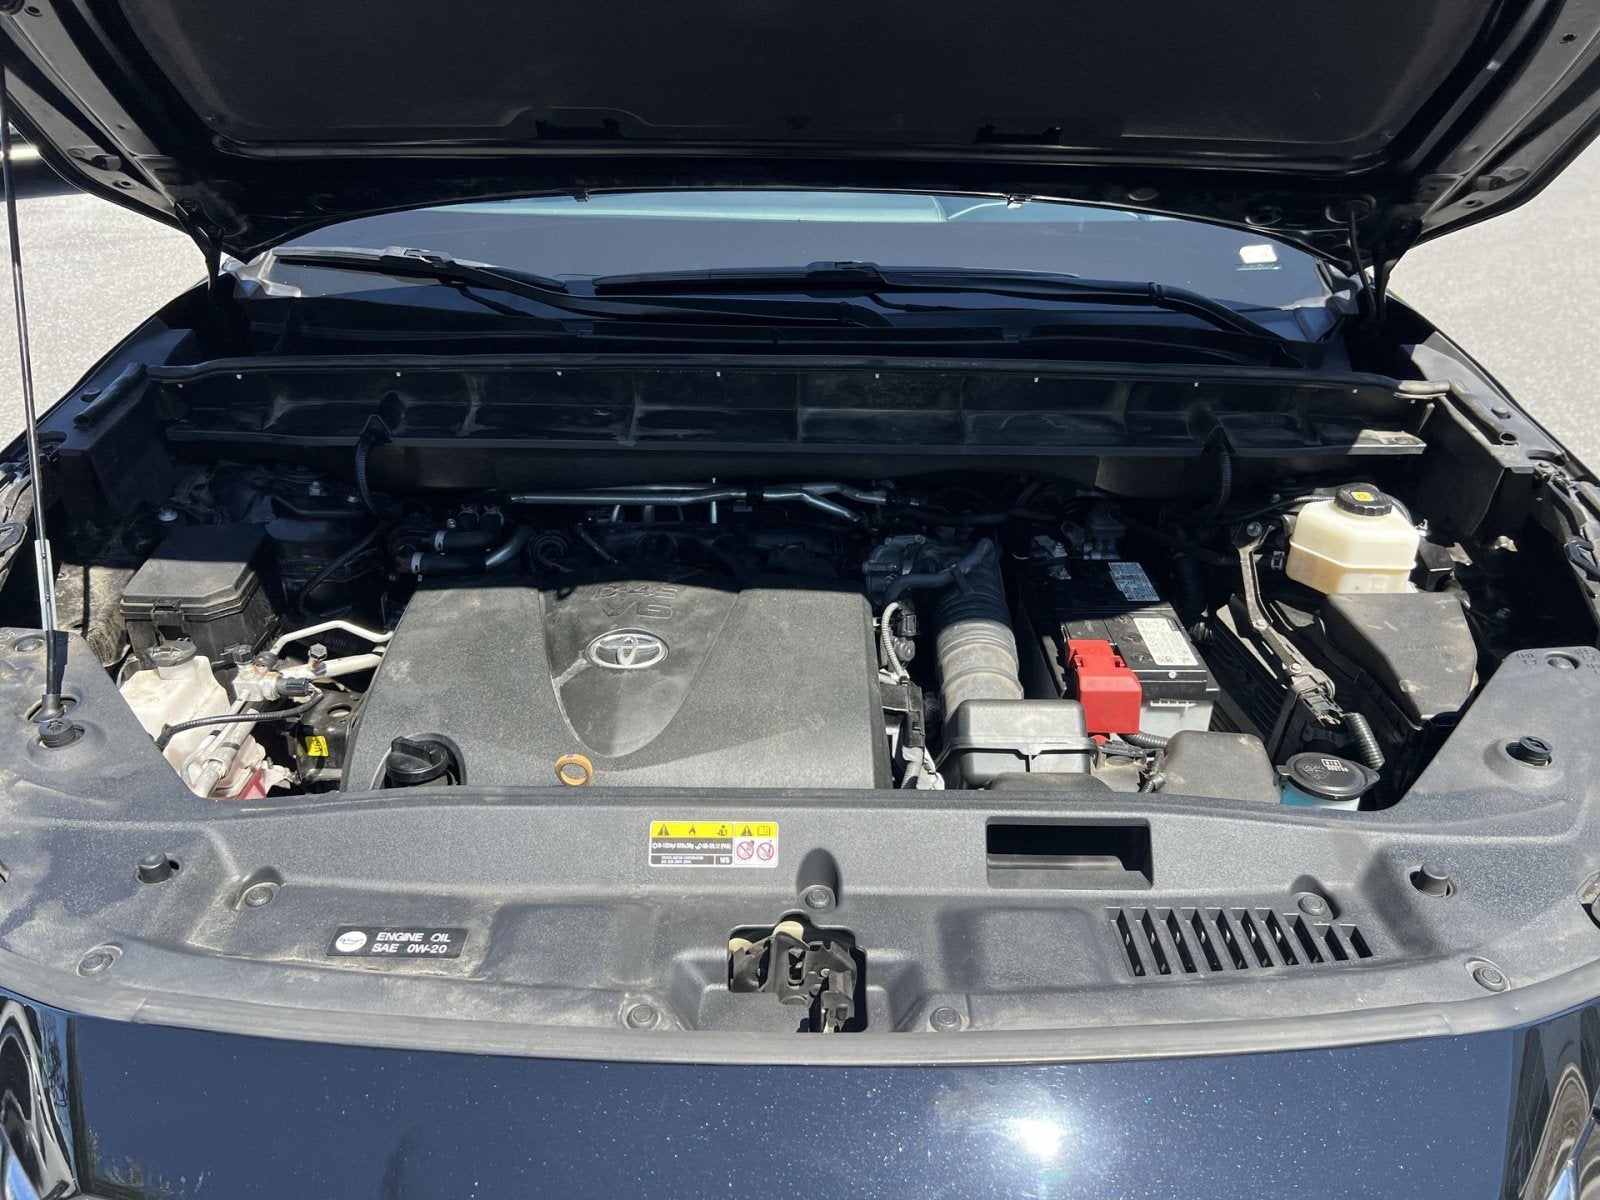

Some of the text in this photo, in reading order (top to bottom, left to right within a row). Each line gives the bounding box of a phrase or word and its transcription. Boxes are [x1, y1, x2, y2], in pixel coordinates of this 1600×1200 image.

[598, 601, 673, 620] V6
[376, 931, 451, 942] ENGINE OIL
[371, 943, 447, 954] SAE 0W-20
